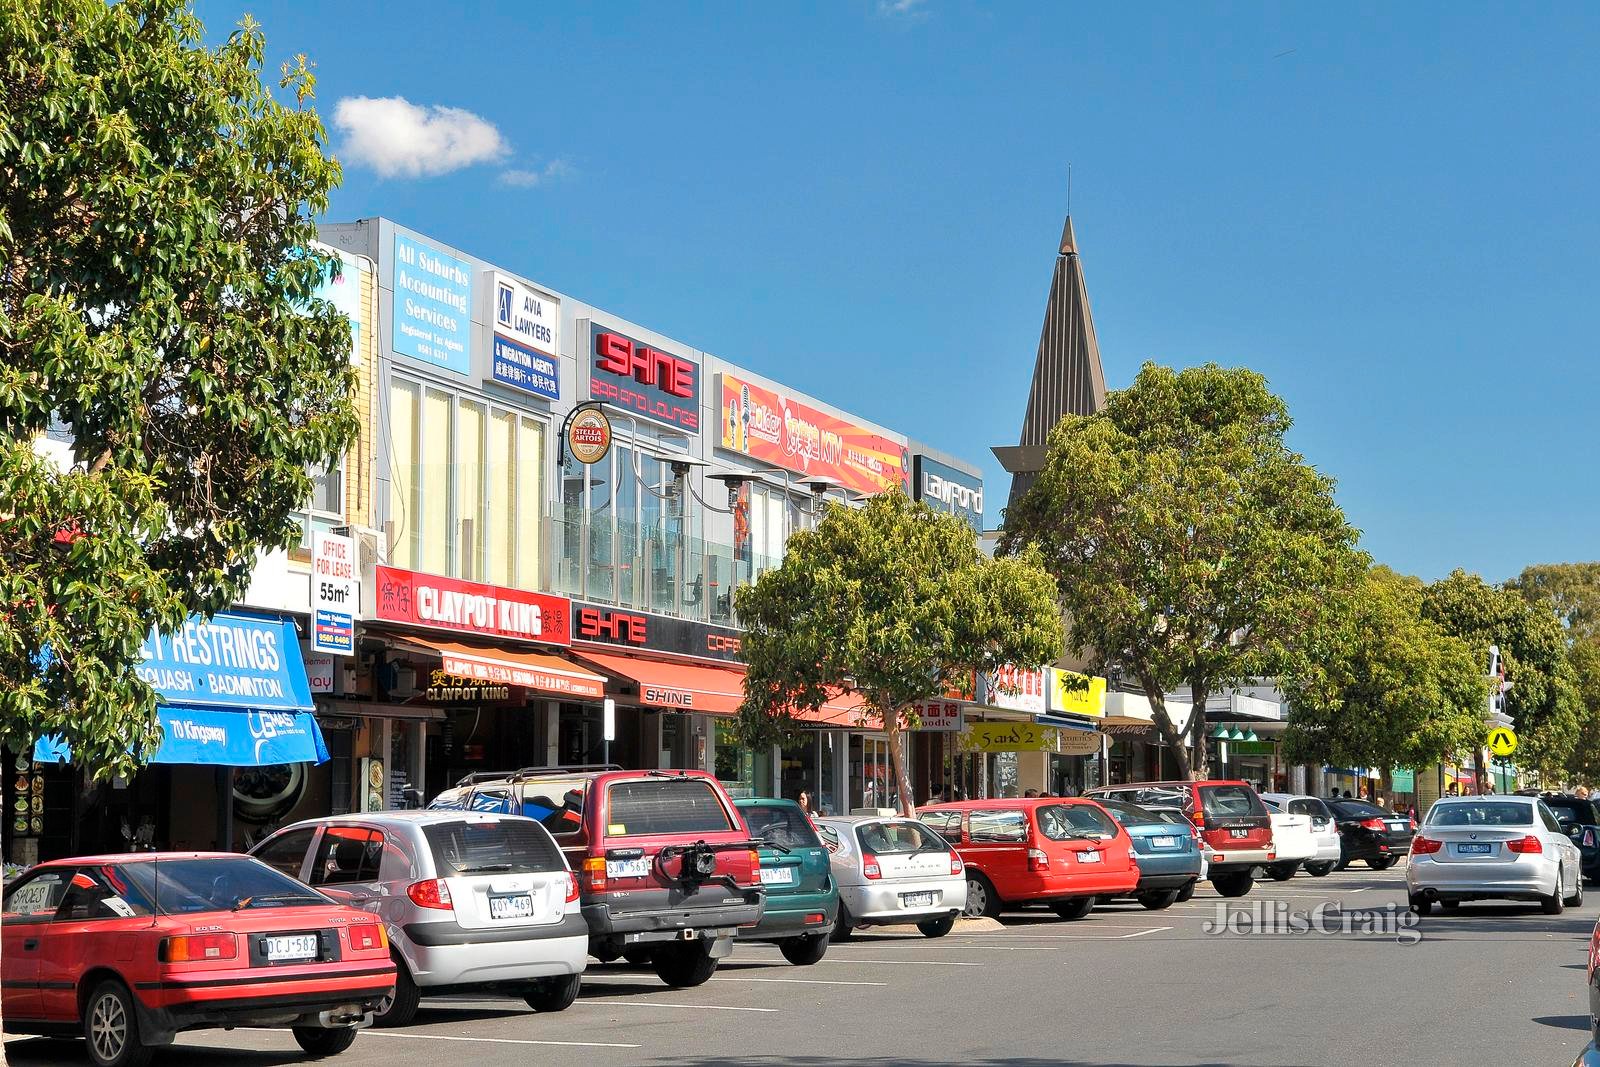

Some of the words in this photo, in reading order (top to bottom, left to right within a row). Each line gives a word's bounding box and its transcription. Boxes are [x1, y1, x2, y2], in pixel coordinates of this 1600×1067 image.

[399, 243, 415, 265] All
[419, 251, 469, 287] Suburbs
[399, 270, 467, 315] Accounting
[405, 298, 457, 333] Services
[524, 296, 542, 318] AVIA
[514, 315, 551, 344] LAWYERS
[495, 342, 501, 357] &
[501, 344, 532, 369] MIGRATION
[532, 357, 554, 377] AGENTS
[591, 378, 618, 401] BAR
[620, 388, 647, 410] AND
[648, 400, 698, 429] LOUNGE
[323, 540, 346, 560] OFFICE
[316, 558, 330, 575] FOR
[332, 562, 352, 579] LEASE
[416, 586, 497, 630] CLAYPOT
[498, 600, 543, 637] KING
[172, 621, 280, 673] RESTRINGS
[135, 666, 195, 692] SQUASH
[207, 673, 284, 698] BADMINTON
[426, 687, 478, 701] CLAYPOT
[481, 686, 509, 700] KING
[645, 689, 693, 707] SHINE
[183, 720, 226, 747] Kingsway
[922, 719, 951, 727] oodle
[982, 732, 991, 748] 5
[994, 727, 1021, 743] and
[1024, 732, 1034, 743] 2
[608, 862, 625, 874] SJW
[630, 861, 647, 872] 563
[13, 887, 46, 904] SHOES
[514, 898, 531, 910] 469
[296, 936, 316, 952] 582
